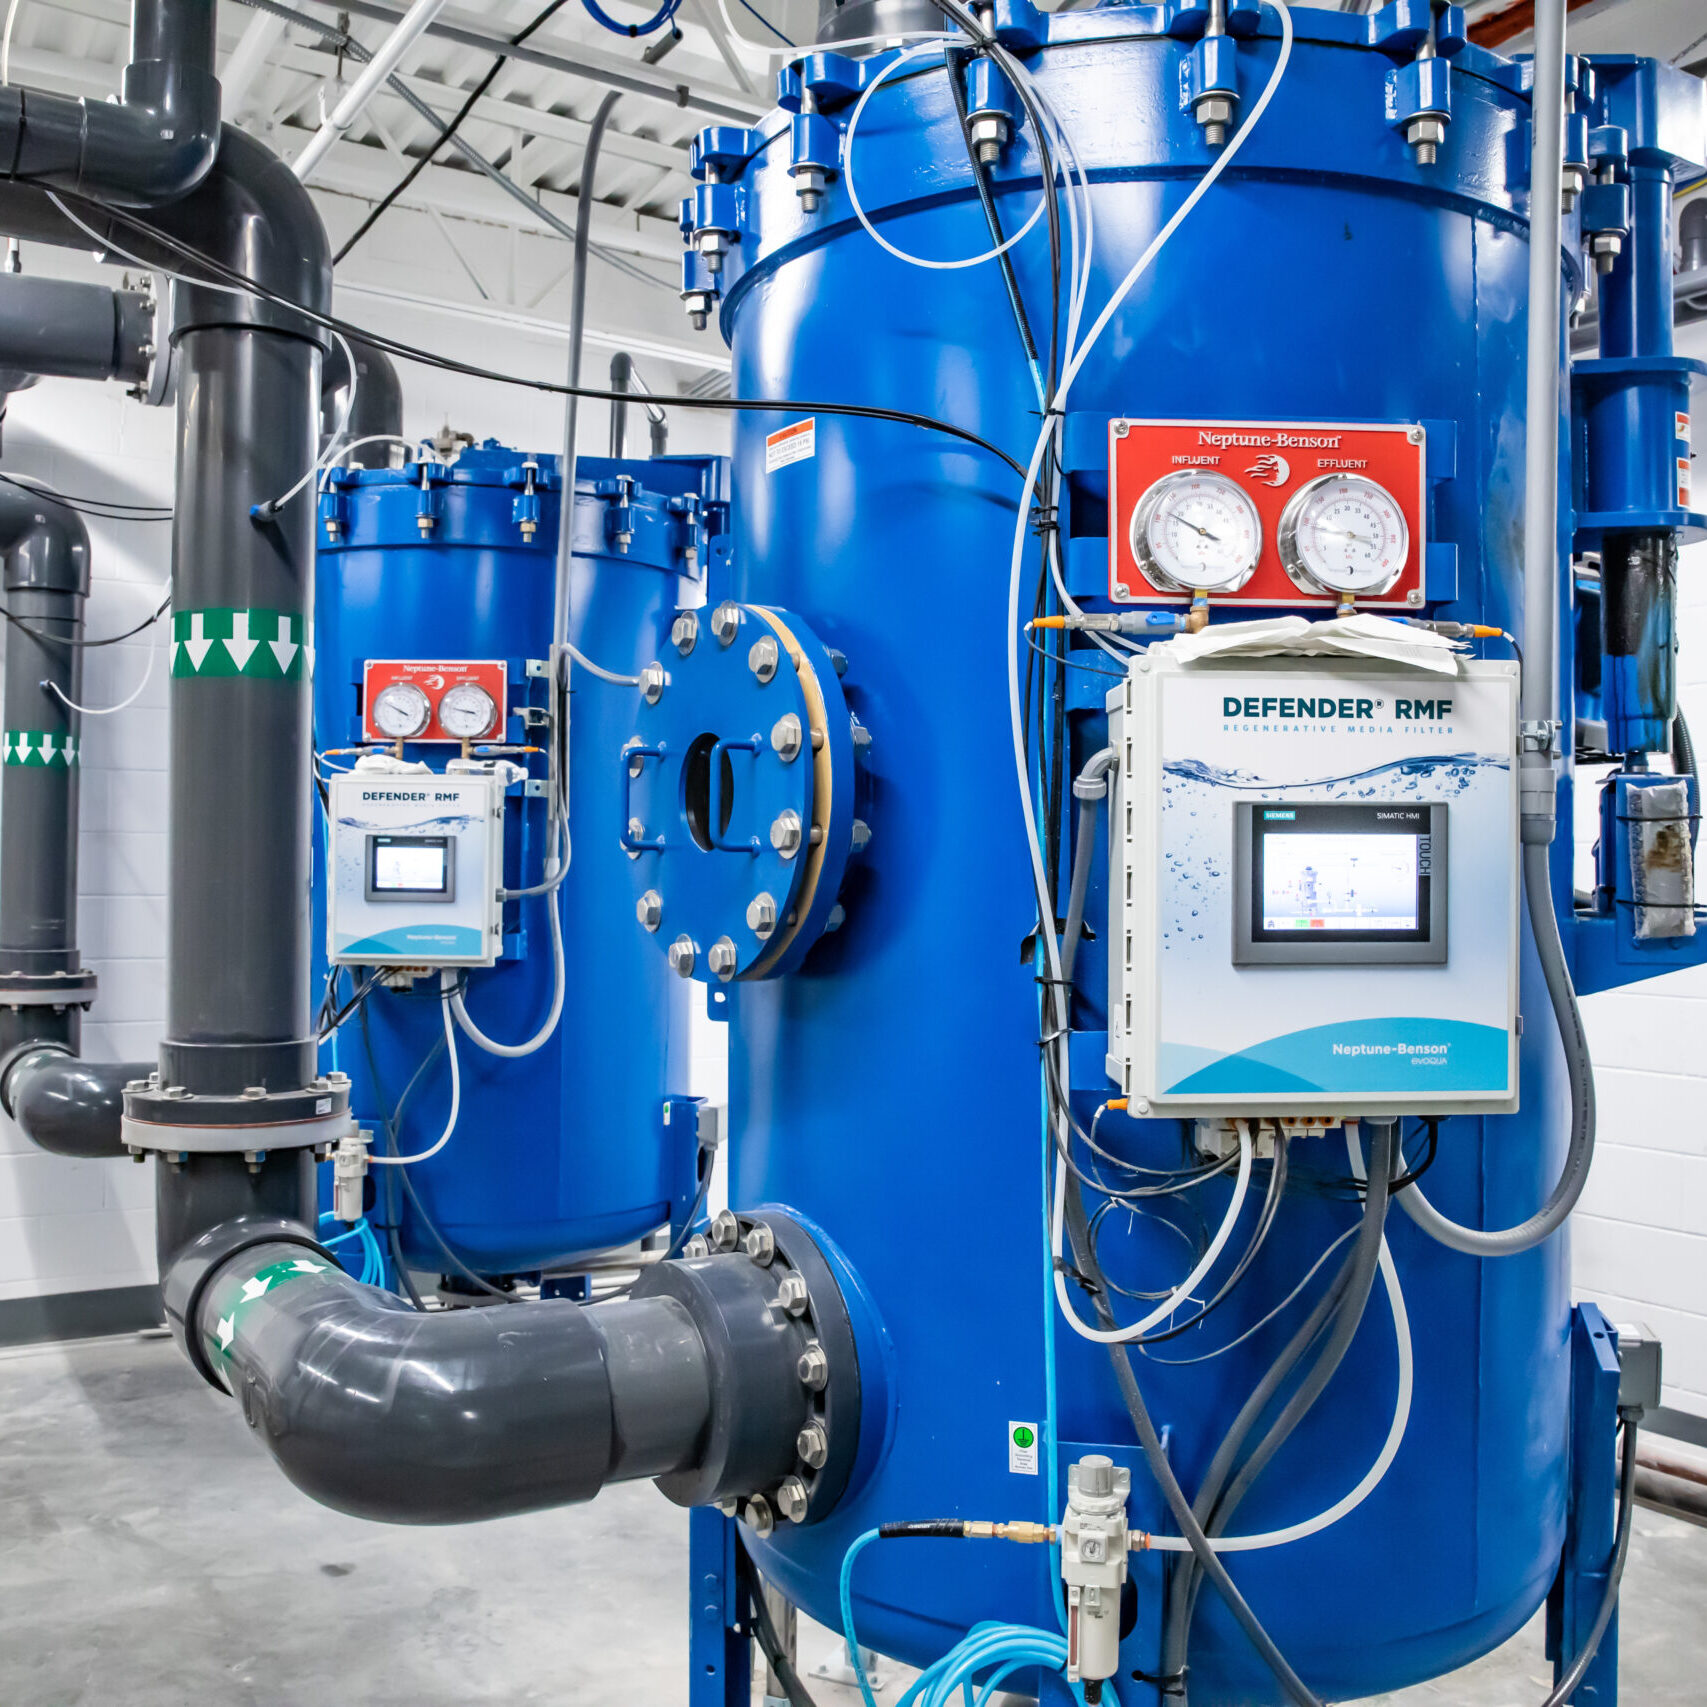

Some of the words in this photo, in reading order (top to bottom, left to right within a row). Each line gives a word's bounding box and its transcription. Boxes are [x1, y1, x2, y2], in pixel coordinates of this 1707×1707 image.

[1172, 455, 1220, 465] INFLUENT
[1317, 459, 1367, 469] EFFLUENT
[1395, 699, 1453, 720] RMF
[1223, 724, 1337, 733] REGENERATIVE
[1347, 725, 1393, 733] MEDIA
[1404, 726, 1453, 734] FILTER
[434, 792, 460, 802] RMF
[1376, 812, 1405, 820] SIMATIC
[1406, 812, 1420, 820] HMI
[1419, 836, 1432, 876] TOUCH
